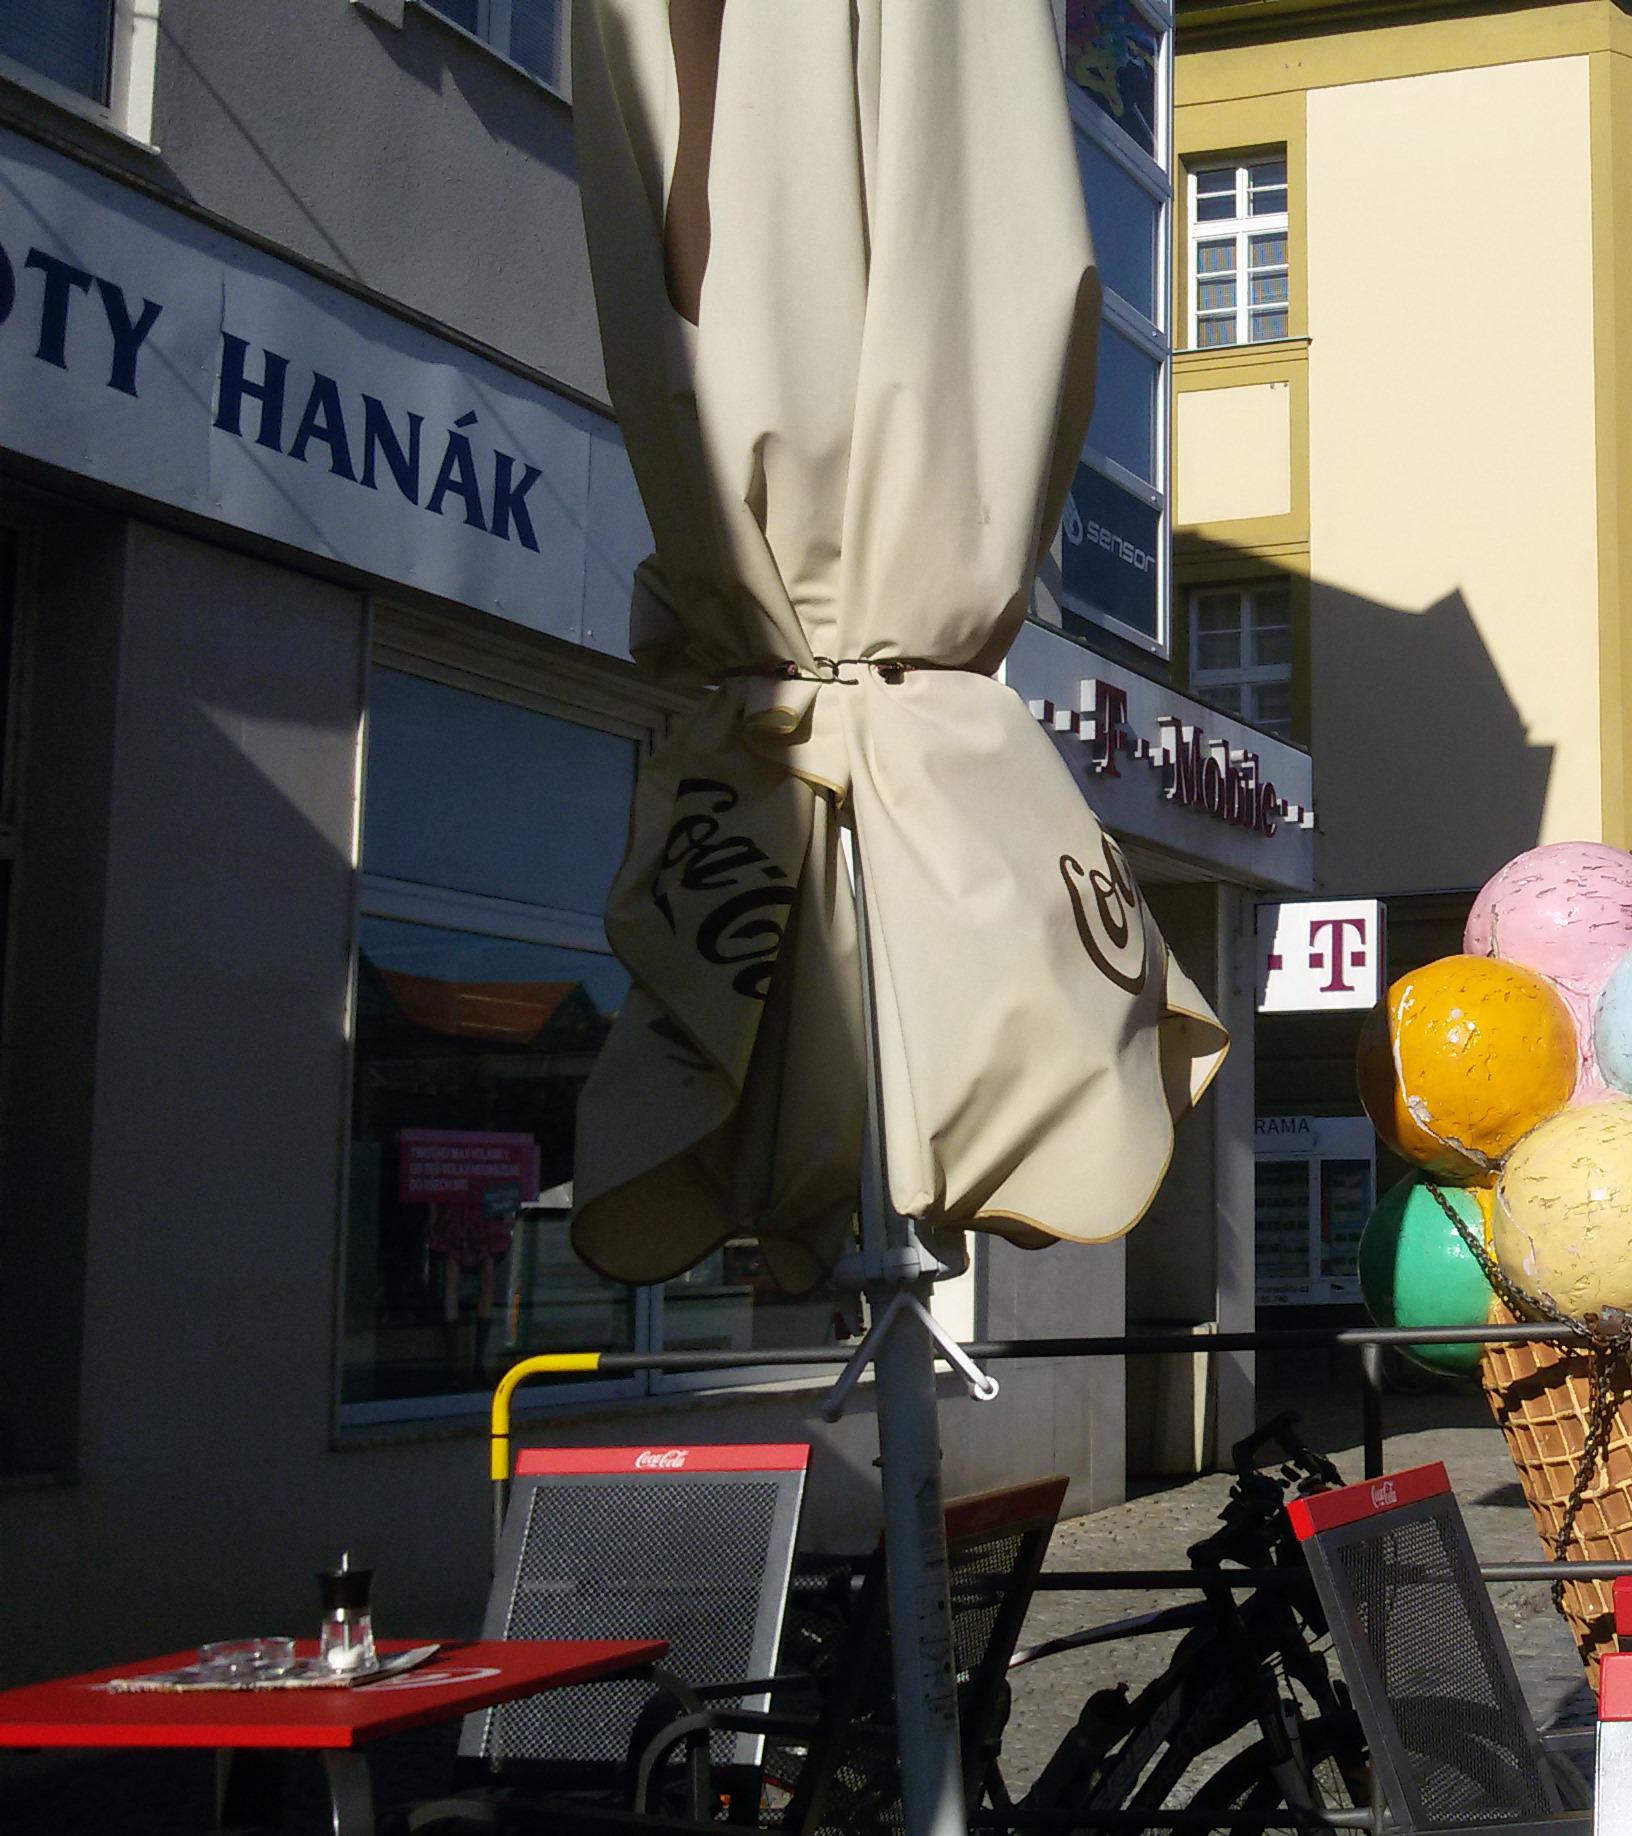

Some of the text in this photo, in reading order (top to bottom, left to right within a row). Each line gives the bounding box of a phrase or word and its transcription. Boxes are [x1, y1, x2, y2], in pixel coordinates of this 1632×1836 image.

[213, 331, 543, 554] HANÁK
[1087, 520, 1156, 573] sensor
[634, 1449, 689, 1468] Coca-Cola
